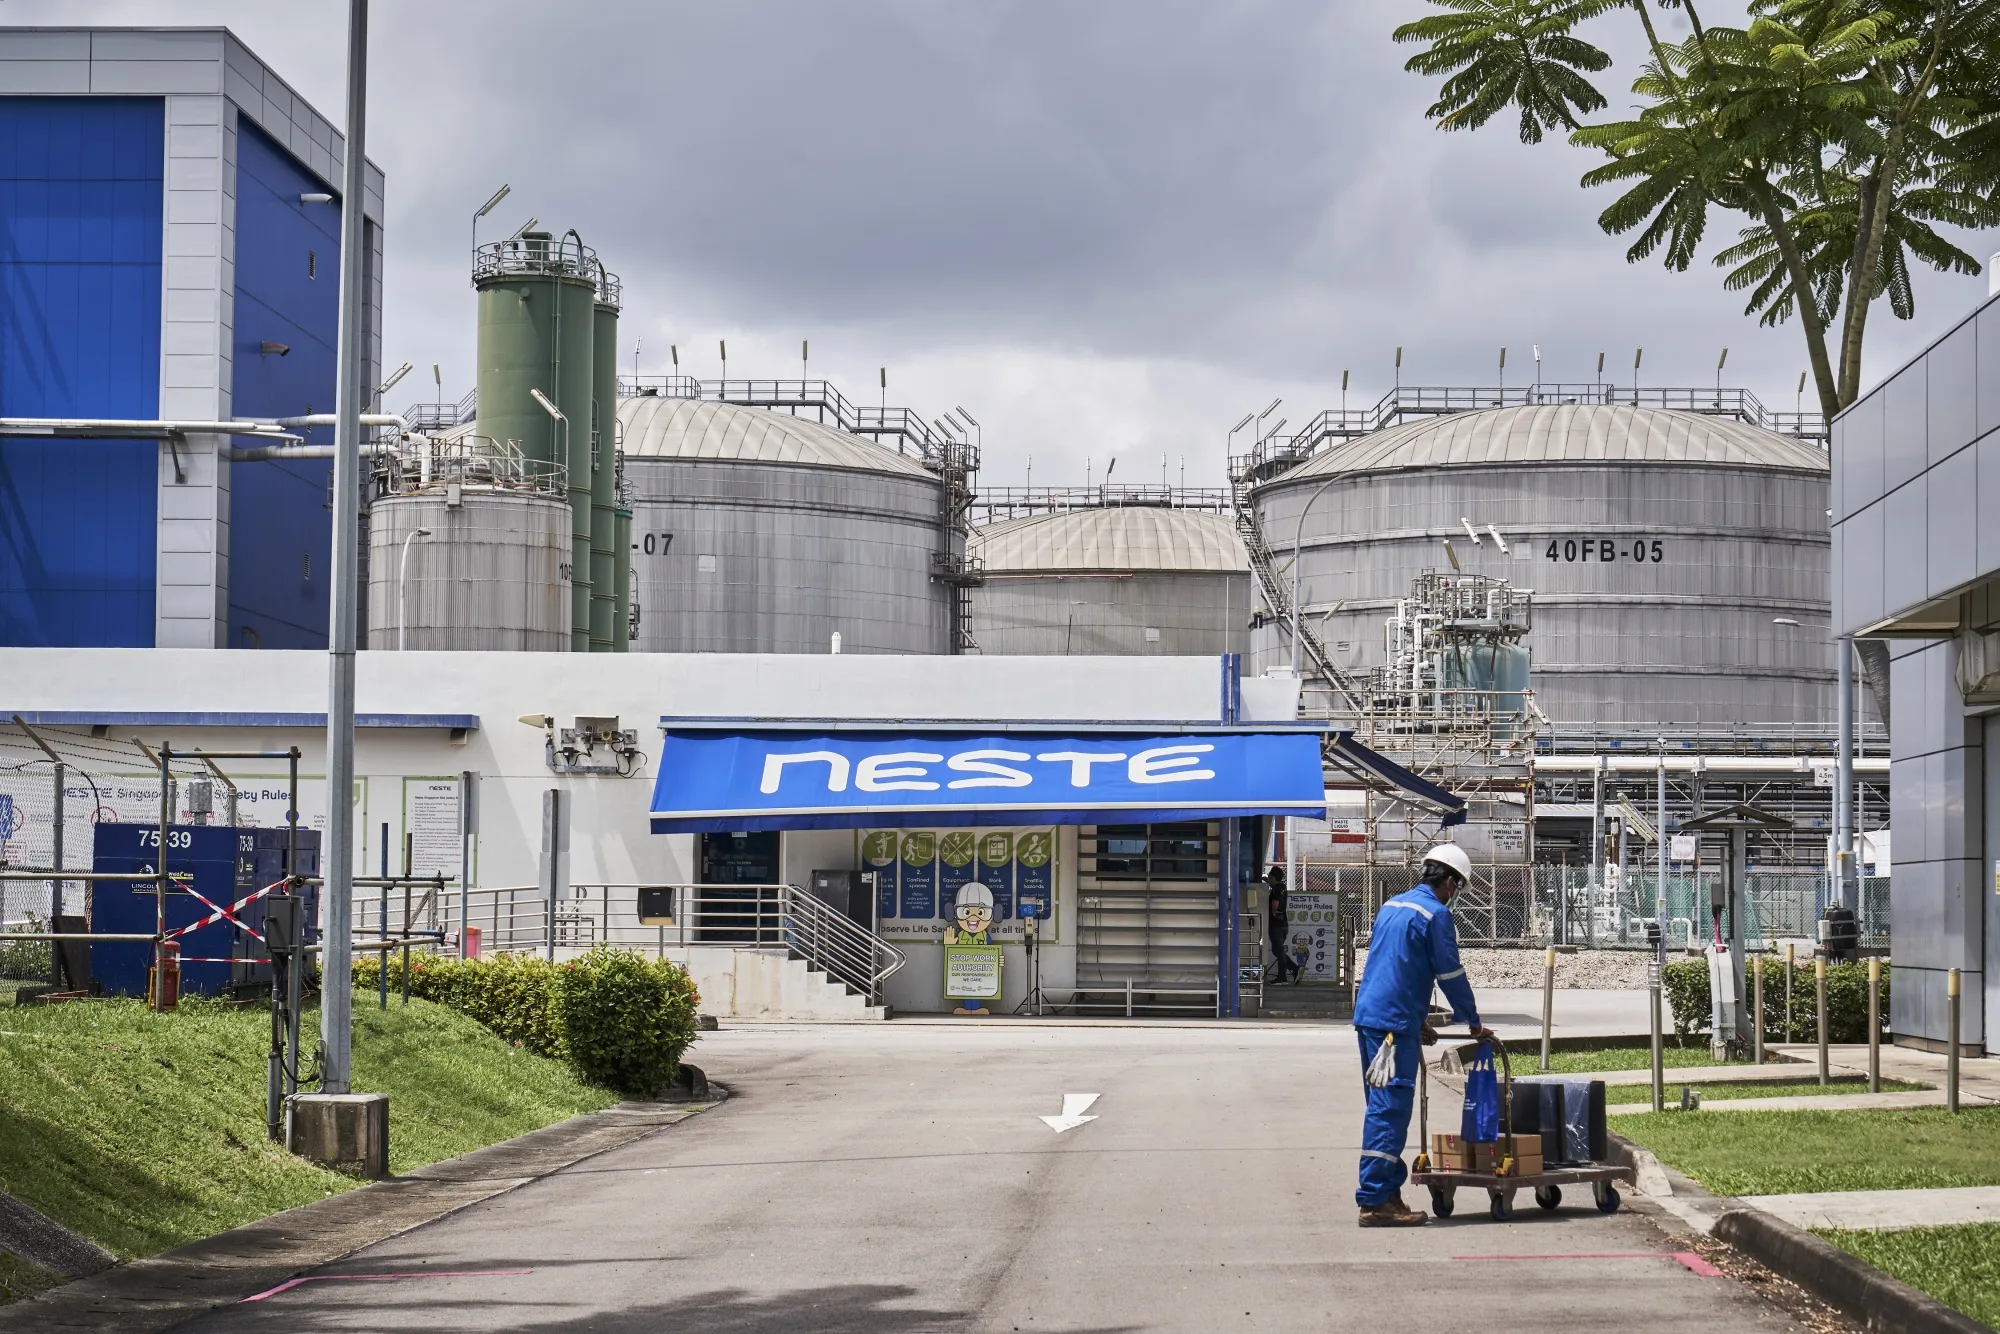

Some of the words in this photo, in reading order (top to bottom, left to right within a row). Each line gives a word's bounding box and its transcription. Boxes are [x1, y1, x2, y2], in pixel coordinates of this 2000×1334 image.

[1545, 540, 1663, 563] 40FB-05
[760, 744, 1215, 794] NESTE
[117, 788, 180, 802] Singape
[214, 789, 257, 802] Saety
[240, 836, 254, 852] 75-39
[912, 924, 929, 932] Life
[1002, 926, 1012, 934] all
[1015, 926, 1039, 934] tis
[950, 954, 970, 962] STOP
[972, 954, 996, 962] WORK
[952, 963, 994, 972] AUTHORITY
